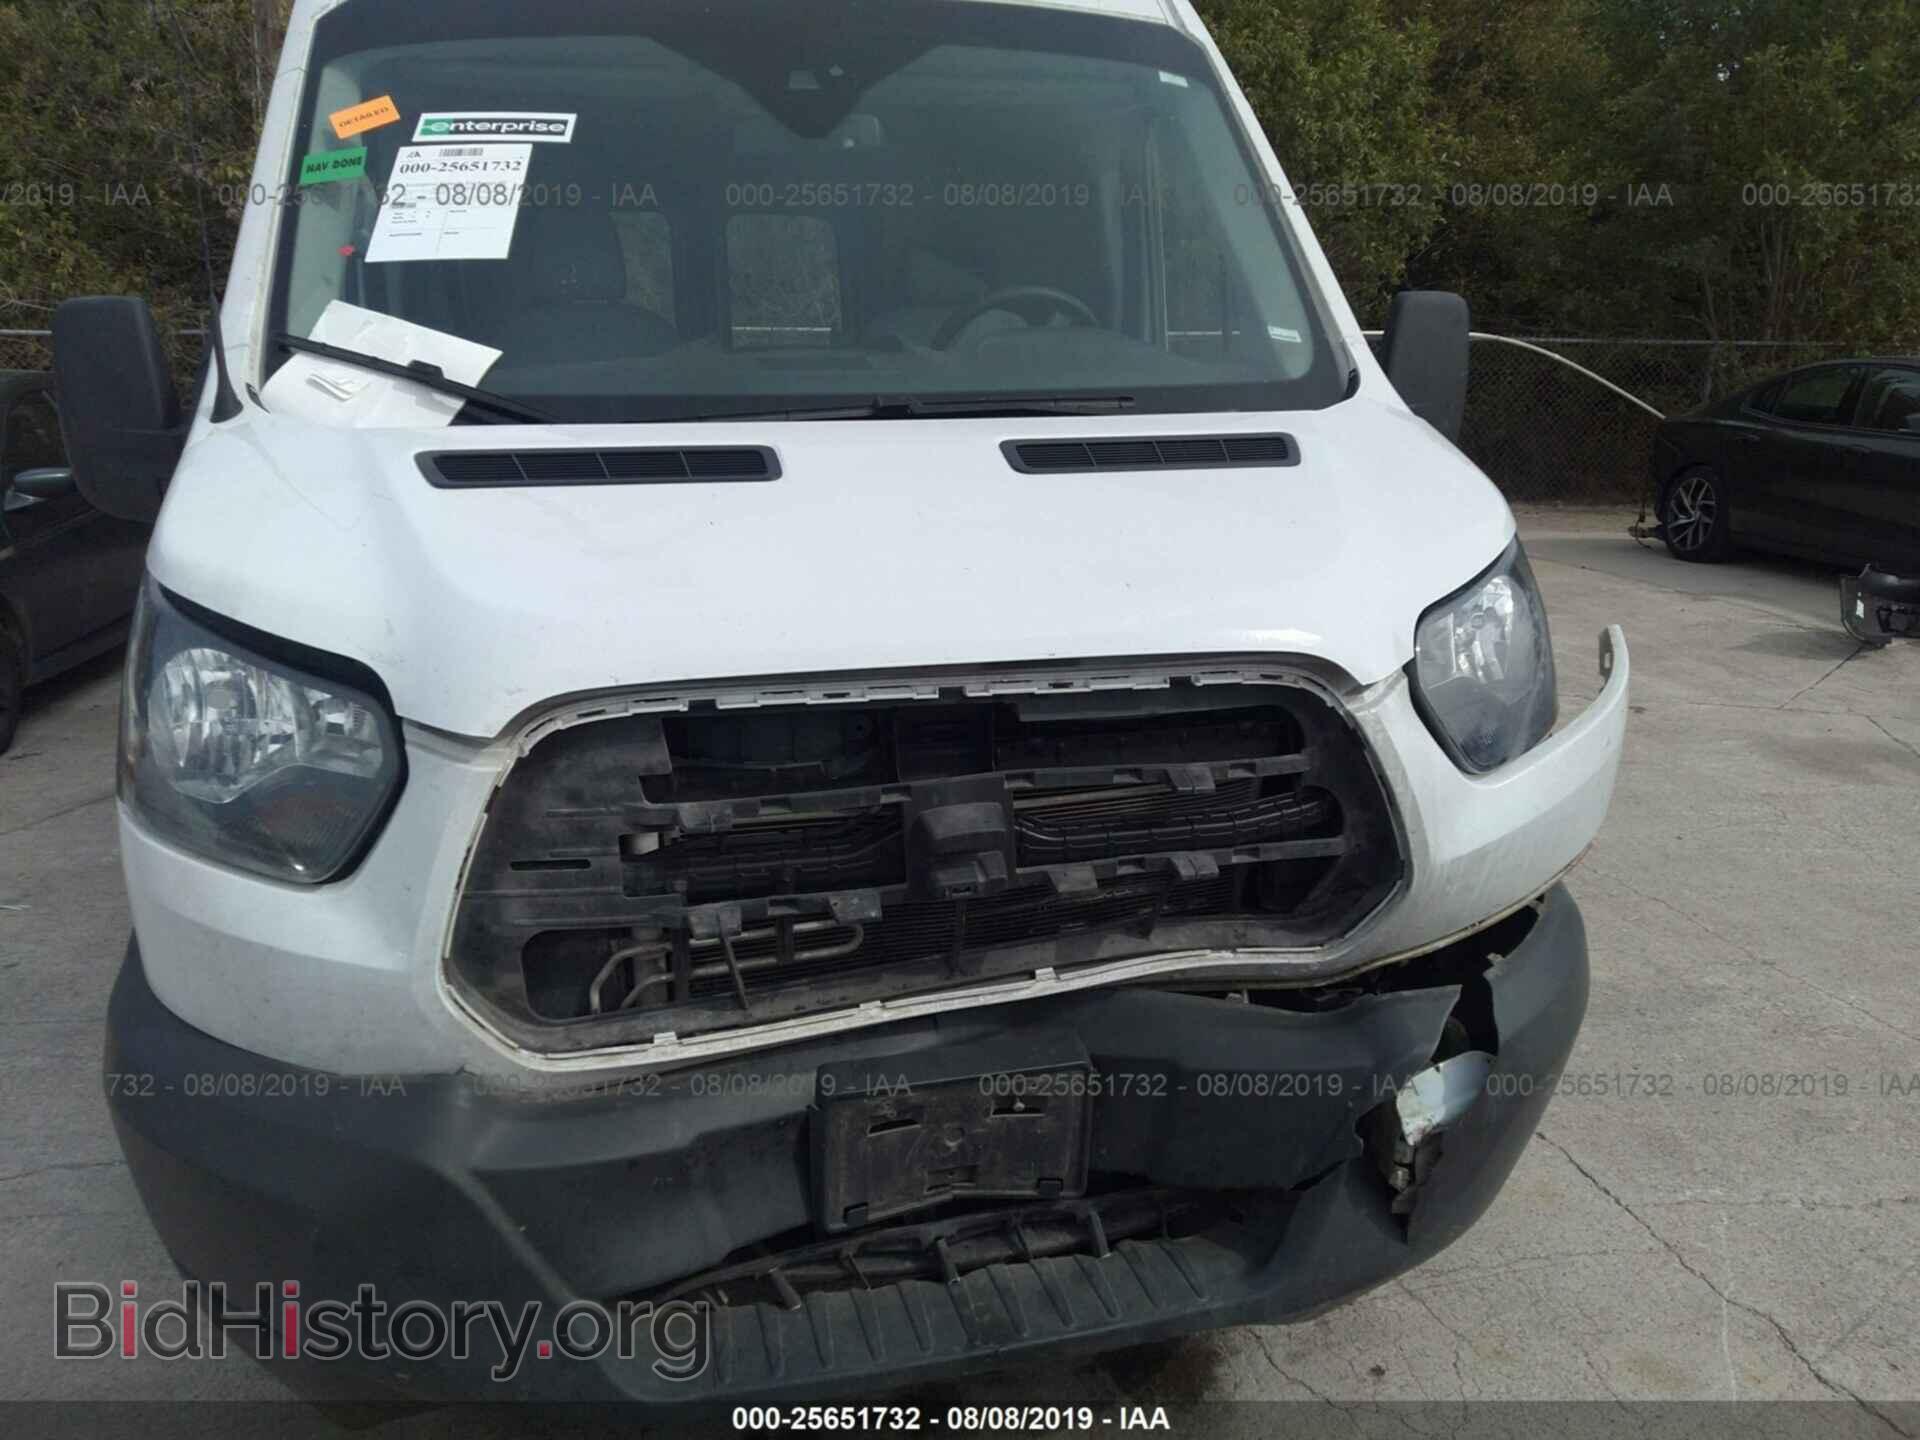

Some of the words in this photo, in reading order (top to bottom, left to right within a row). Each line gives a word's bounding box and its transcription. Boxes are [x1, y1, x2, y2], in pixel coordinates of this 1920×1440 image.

[424, 120, 566, 134] enterprise
[306, 160, 328, 174] NAV
[332, 156, 363, 170] DONE
[399, 160, 522, 175] 000-25651732
